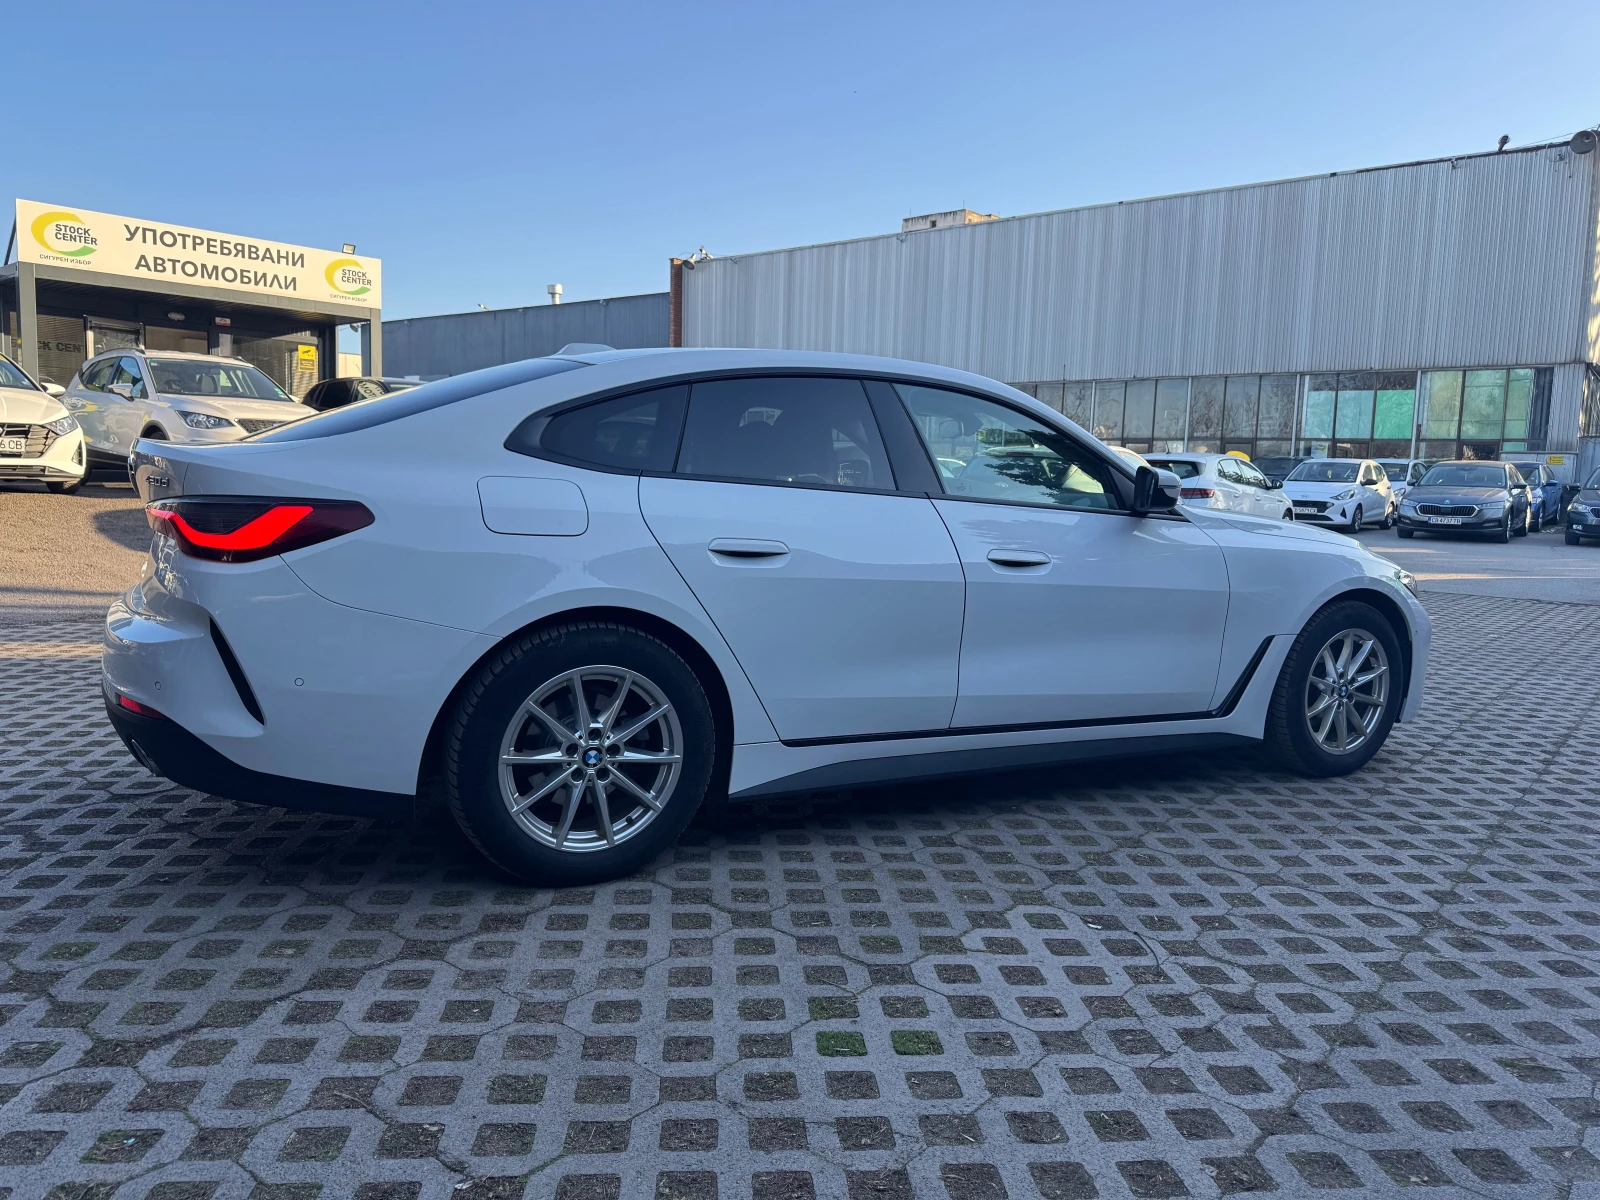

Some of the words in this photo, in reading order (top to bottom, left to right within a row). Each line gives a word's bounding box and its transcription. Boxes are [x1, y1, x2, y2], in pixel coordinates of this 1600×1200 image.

[55, 223, 91, 237] STOCK
[54, 231, 98, 246] CENTER
[123, 223, 305, 269] УПОТРЕБЯВАНИ
[39, 253, 69, 263] СИГУРЕН
[69, 258, 92, 266] ИЗБОР
[134, 254, 297, 292] АВТОМОБИЛИ
[341, 268, 368, 279] STOCK
[341, 275, 372, 287] CENTER
